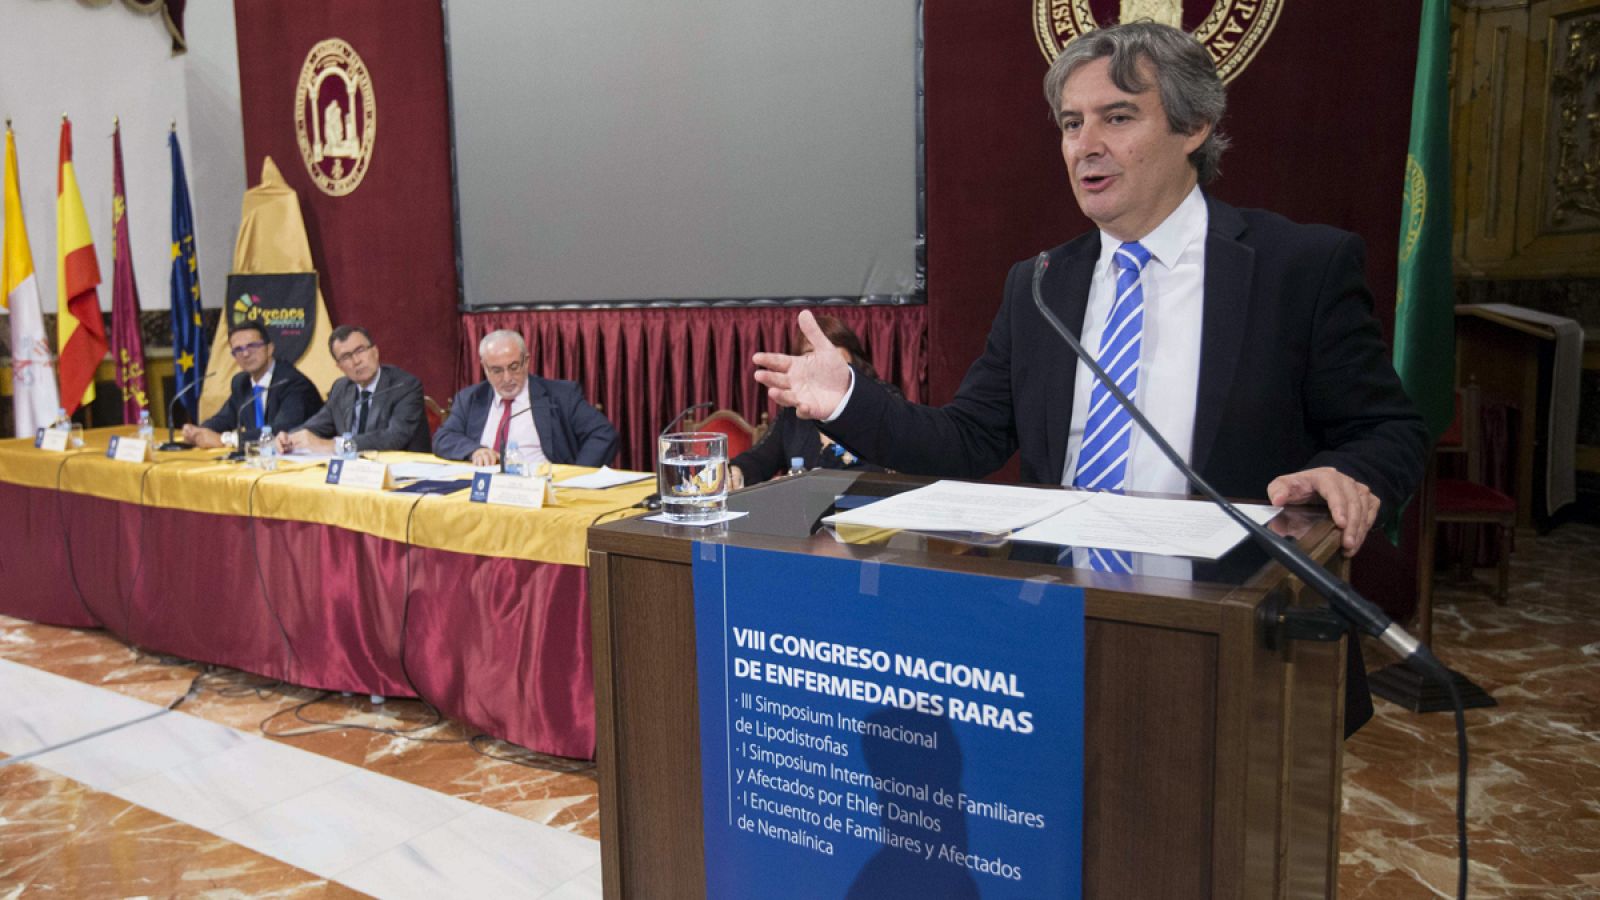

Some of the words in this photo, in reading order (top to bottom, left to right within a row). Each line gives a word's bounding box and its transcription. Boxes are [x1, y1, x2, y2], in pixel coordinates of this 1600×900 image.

[733, 627, 765, 650] VIII
[769, 633, 891, 672] CONGRESO
[895, 654, 1024, 698] NACIONAL
[734, 657, 762, 681] DE
[765, 663, 944, 716] ENFERMEDADES
[949, 698, 1034, 734] RARAS
[735, 716, 753, 735] de
[756, 720, 849, 757] Lipodistrofias
[741, 692, 752, 709] III
[755, 695, 834, 728] Simposium
[838, 712, 937, 749] Internacional
[736, 768, 745, 784] y
[747, 768, 815, 799] Afectados
[818, 789, 843, 807] por
[846, 792, 884, 816] Ehler
[887, 802, 941, 832] Danlos
[749, 743, 827, 777] Simposium
[830, 763, 928, 801] Internacional
[932, 788, 954, 808] de
[958, 793, 1045, 828] Familiares
[737, 814, 755, 833] de
[758, 818, 833, 856] Nemalínica
[750, 792, 820, 825] Encuentro
[823, 813, 842, 832] de
[846, 818, 921, 853] Familiares
[925, 843, 934, 860] y
[938, 843, 1022, 880] Afectados
